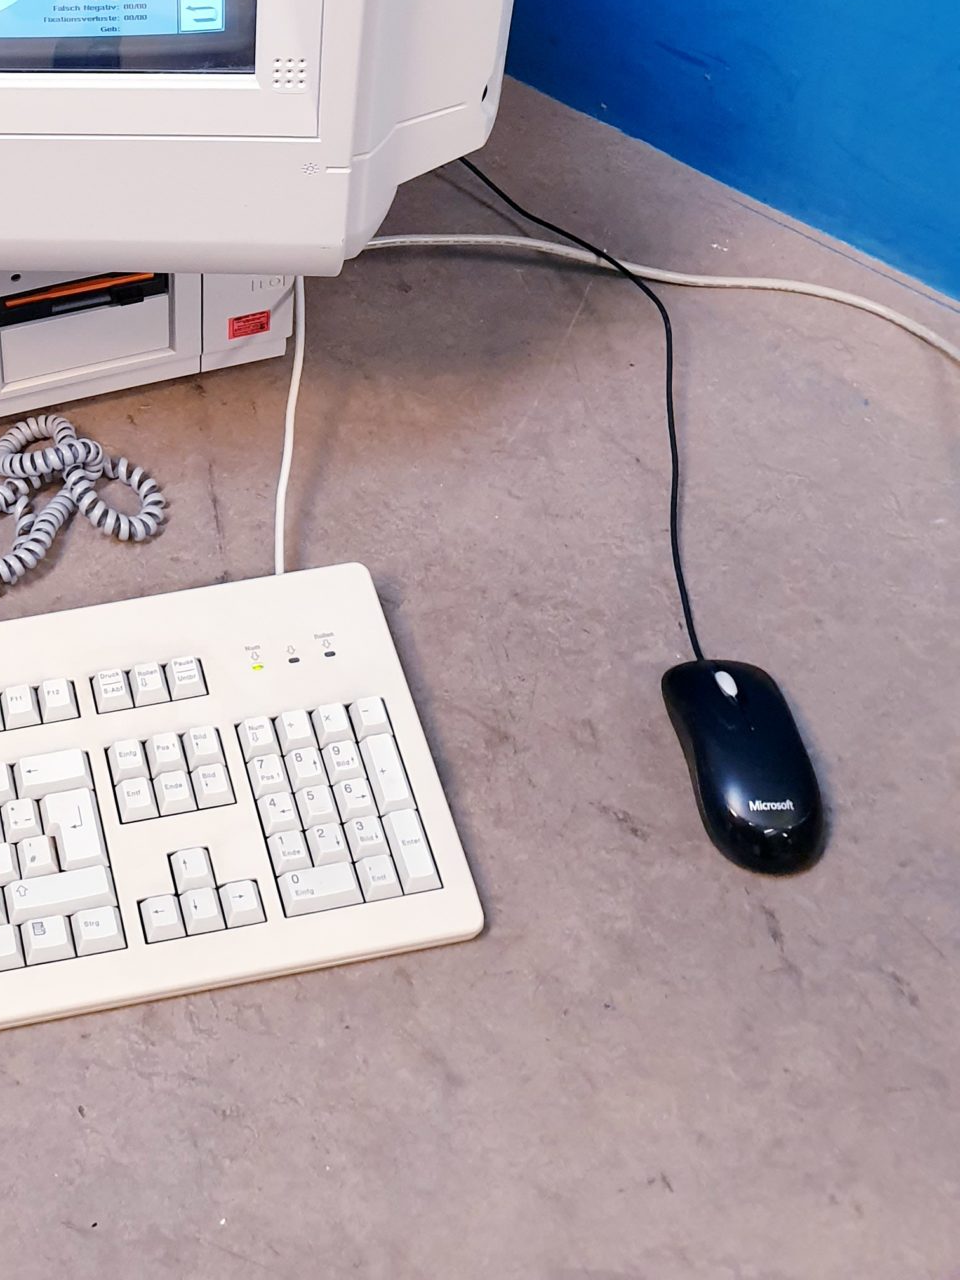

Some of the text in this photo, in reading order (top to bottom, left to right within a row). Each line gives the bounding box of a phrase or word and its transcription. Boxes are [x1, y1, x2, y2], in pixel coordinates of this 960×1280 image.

[332, 745, 341, 756] 9
[294, 752, 303, 763] 8
[256, 759, 265, 769] 7
[343, 783, 353, 794] 6
[306, 790, 315, 801] 5
[268, 797, 277, 808] 4
[748, 799, 795, 812] Microsoft
[355, 821, 364, 831] 3
[316, 828, 326, 838] 2
[277, 835, 285, 845] 1
[291, 873, 300, 885] 0
